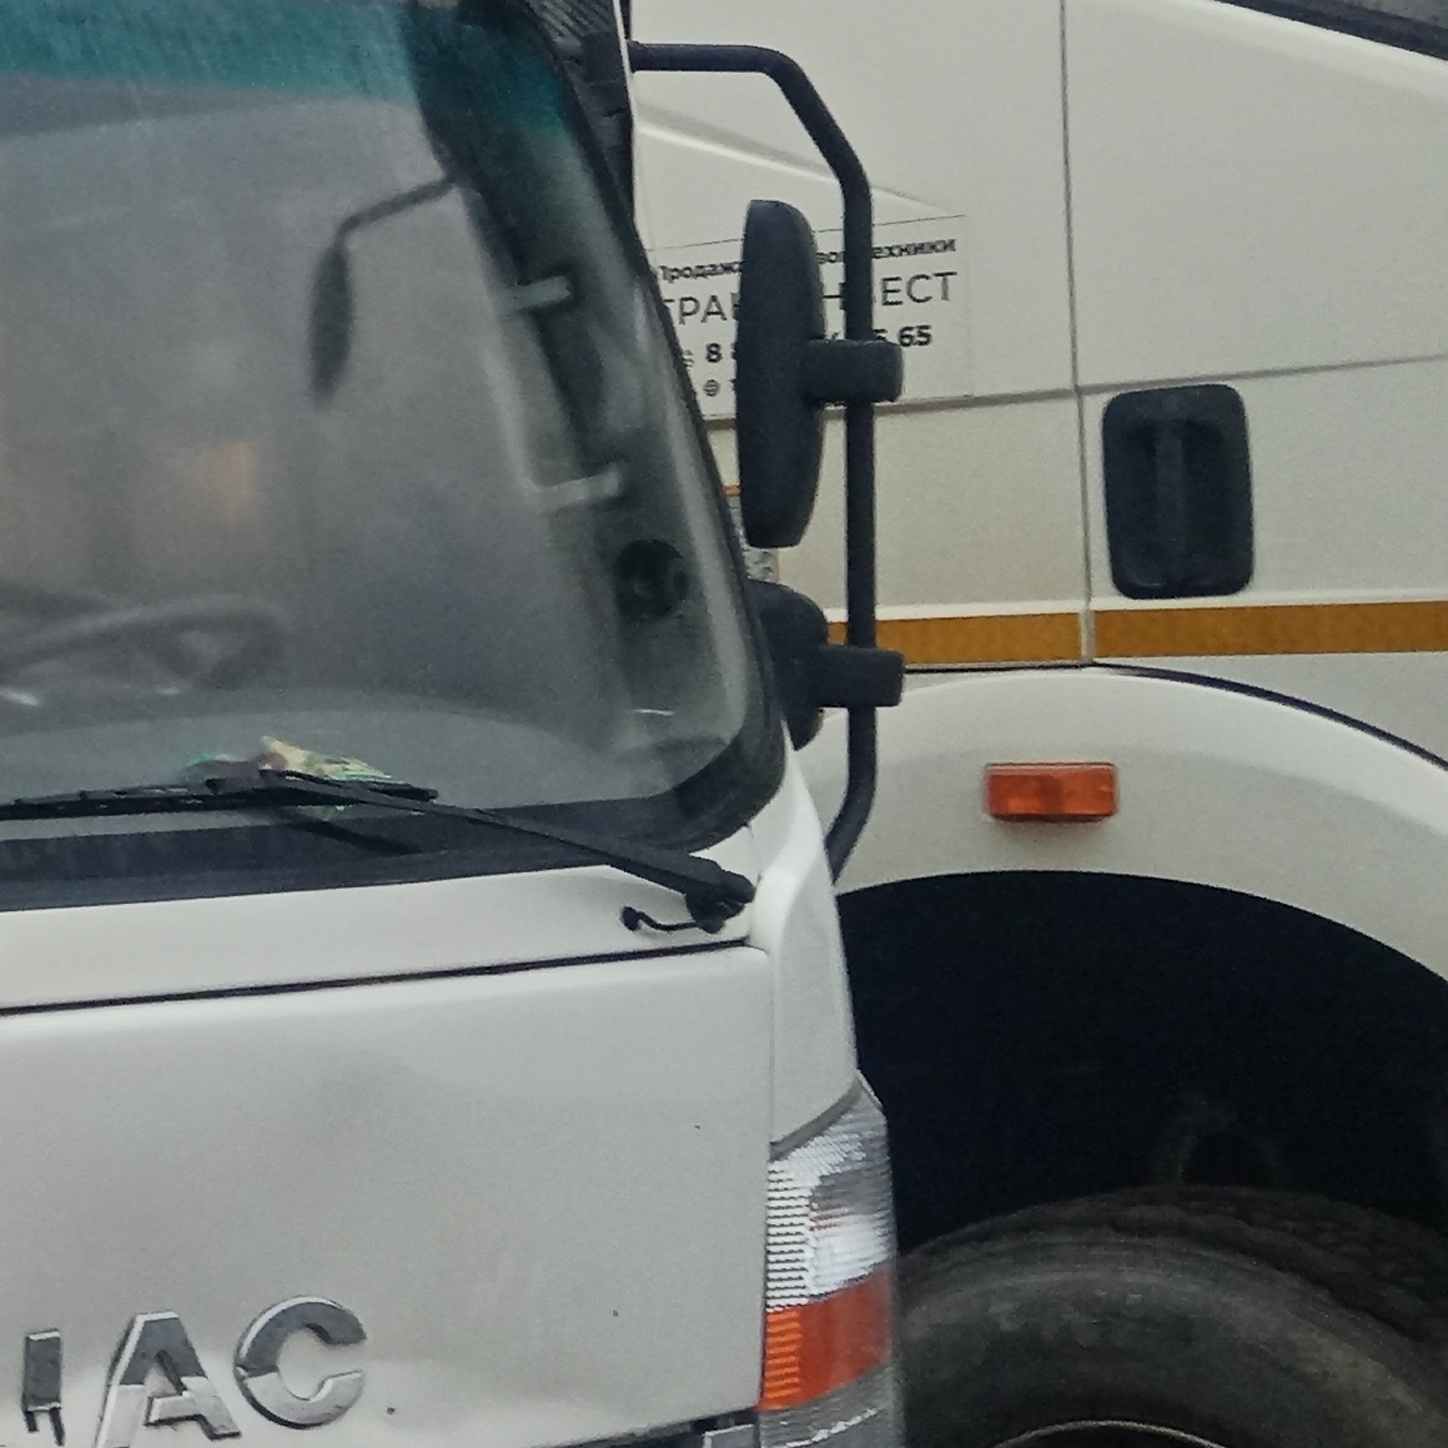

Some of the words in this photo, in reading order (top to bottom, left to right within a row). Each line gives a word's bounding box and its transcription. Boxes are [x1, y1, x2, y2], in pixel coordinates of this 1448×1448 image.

[658, 260, 742, 284] родаж
[873, 238, 956, 260] ехники
[898, 325, 933, 348] 65
